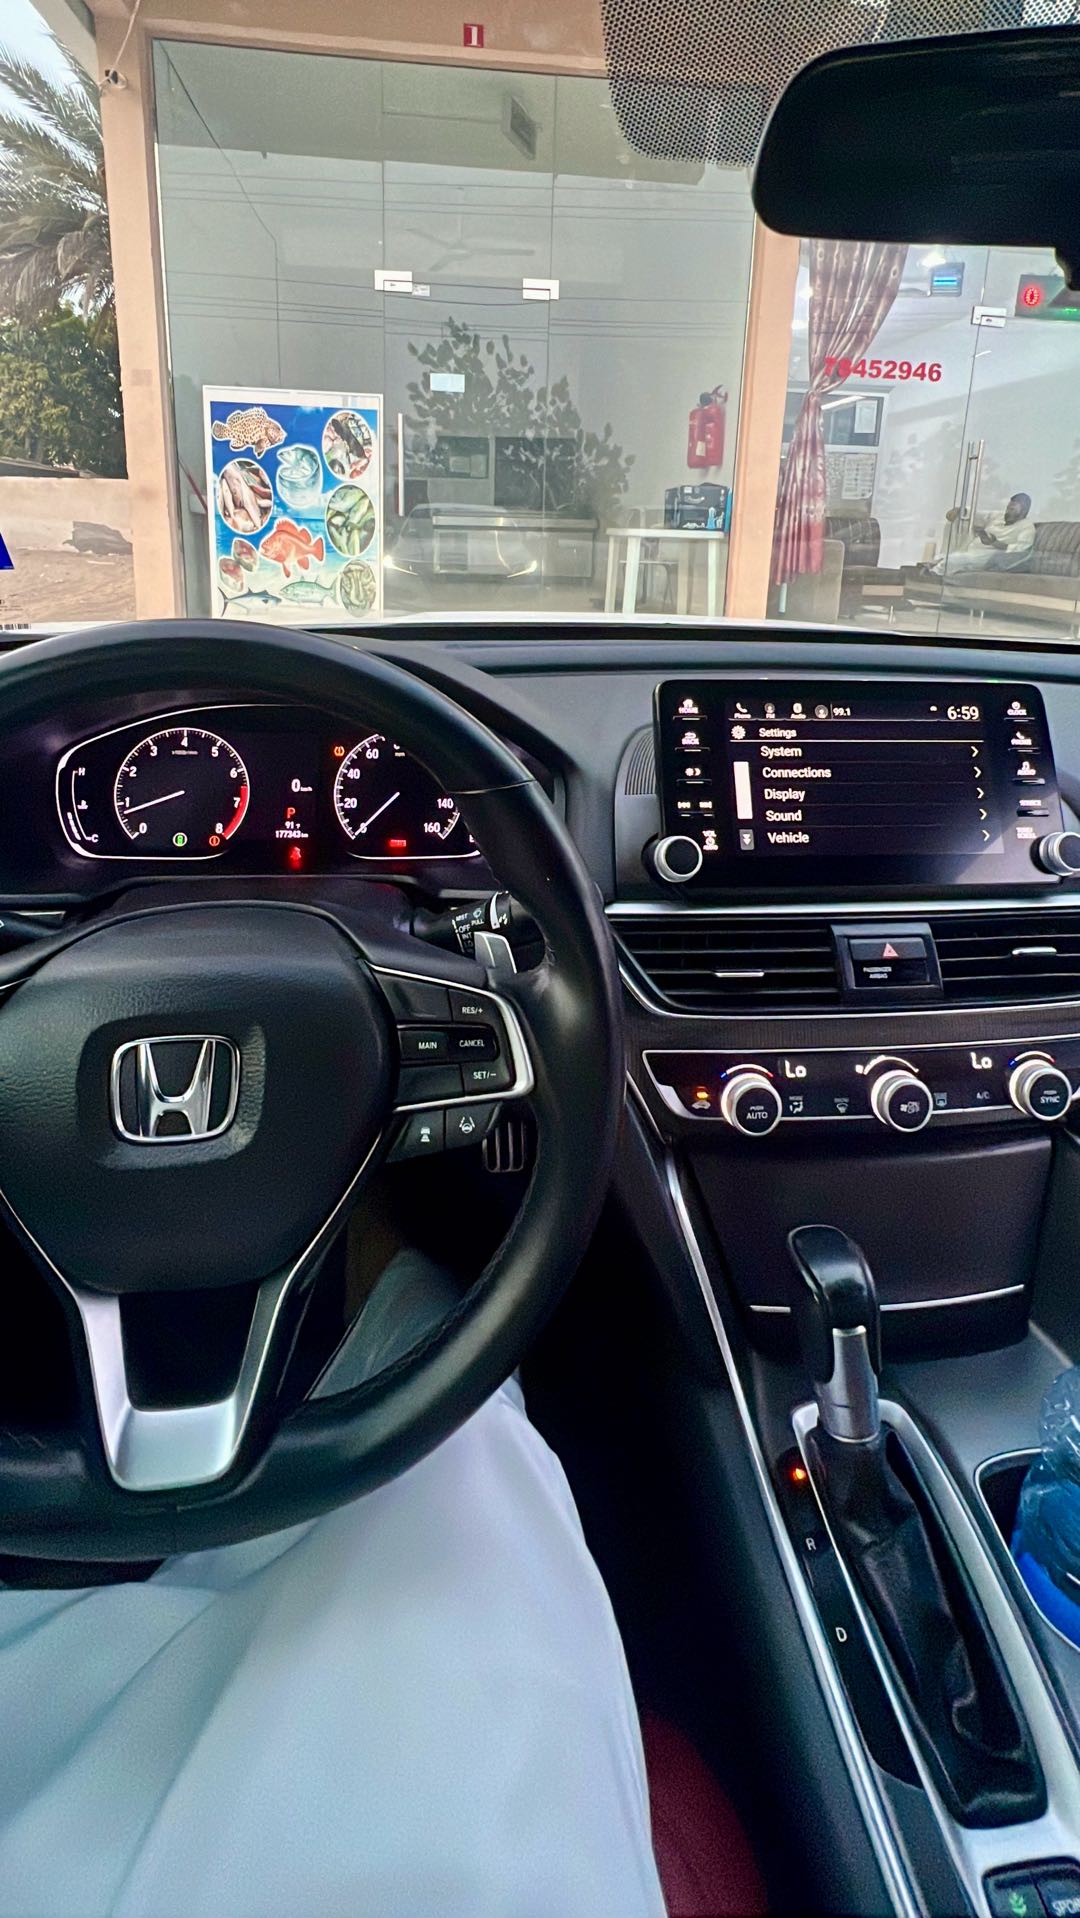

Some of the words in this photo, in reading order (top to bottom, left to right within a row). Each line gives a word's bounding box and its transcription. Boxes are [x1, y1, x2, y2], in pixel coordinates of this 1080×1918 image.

[833, 707, 851, 717] 99.1
[947, 706, 979, 720] 6:59
[758, 727, 798, 740] Settings
[181, 736, 189, 747] 4
[150, 745, 158, 757] 3
[211, 746, 219, 757] 5
[365, 748, 380, 760] 60
[760, 745, 803, 759] System
[78, 767, 86, 776] H
[129, 766, 137, 777] 2
[229, 767, 238, 778] 6
[346, 768, 361, 780] 40
[762, 766, 832, 779] Connections
[291, 778, 300, 793] 0
[764, 788, 806, 802] Display
[124, 797, 130, 807] 1
[233, 797, 241, 809] 7
[343, 798, 358, 809] 20
[437, 797, 454, 809] 140
[286, 807, 296, 819] P
[765, 809, 803, 822] Sound
[139, 822, 148, 834] 0
[215, 823, 224, 834] 8
[285, 821, 295, 830] 91
[424, 822, 441, 834] 160
[91, 833, 99, 843] C
[275, 829, 301, 839] 177343
[767, 831, 809, 844] Vehicle
[458, 923, 471, 933] OFF
[461, 1006, 484, 1015] RES/+
[418, 1041, 438, 1050] MAIN
[459, 1039, 485, 1048] CANCEL
[976, 1091, 990, 1100] A/C
[1040, 1096, 1060, 1104] SYNC
[746, 1111, 768, 1120] AUTO
[805, 1537, 816, 1551] R
[835, 1626, 848, 1643] D
